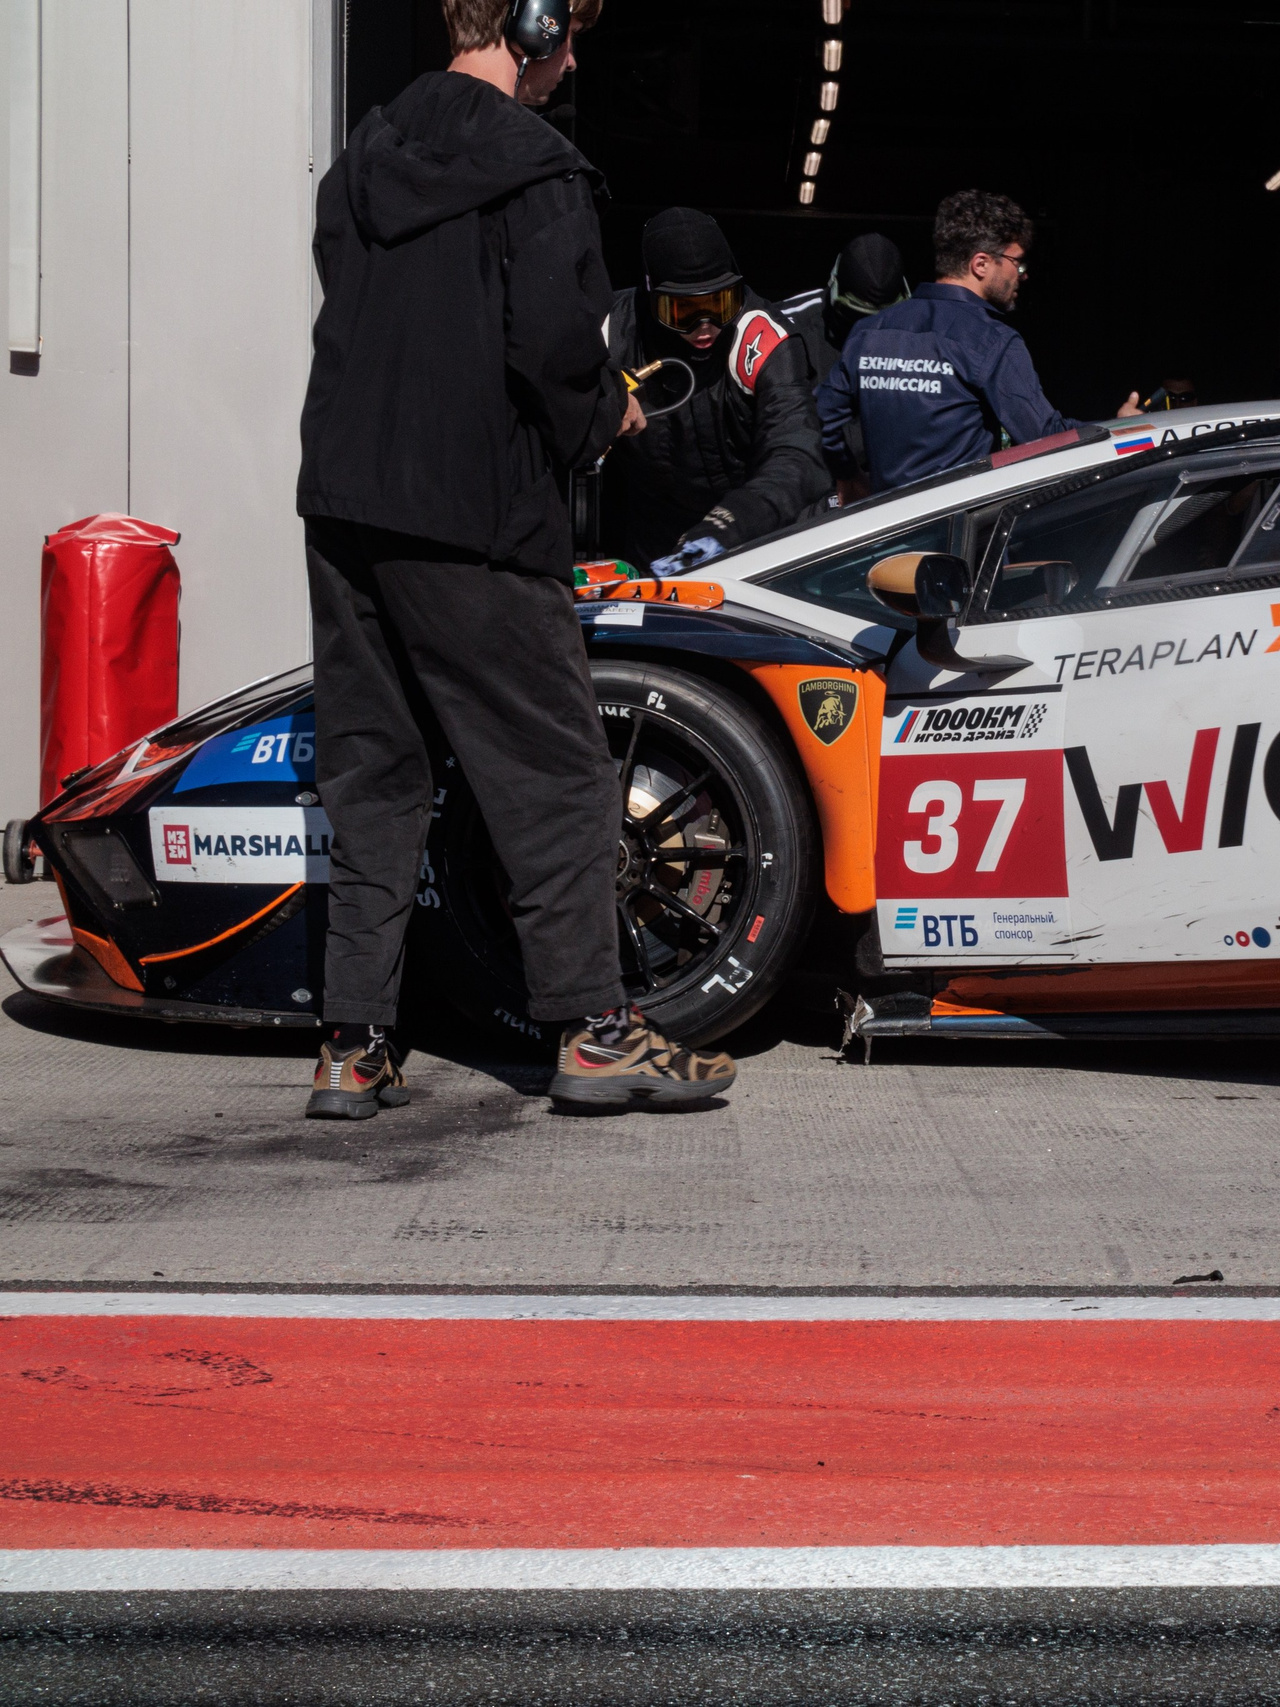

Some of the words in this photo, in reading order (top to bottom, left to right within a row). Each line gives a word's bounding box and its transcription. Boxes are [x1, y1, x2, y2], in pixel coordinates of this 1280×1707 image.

[858, 356, 954, 376] ЕХНИЧЕСКАЯ
[860, 375, 942, 394] КОМИССИЯ
[1053, 629, 1258, 684] TERAPLAN
[801, 680, 856, 694] LAMBORGHINI
[646, 691, 667, 710] FL
[913, 732, 962, 744] ИГОРА
[962, 727, 1016, 743] ДРАЙВ
[251, 731, 315, 764] ВТБ
[903, 778, 1027, 874] 37
[993, 911, 1055, 925] Генеральный
[922, 915, 979, 948] ВТБ
[994, 930, 1034, 942] спонсор
